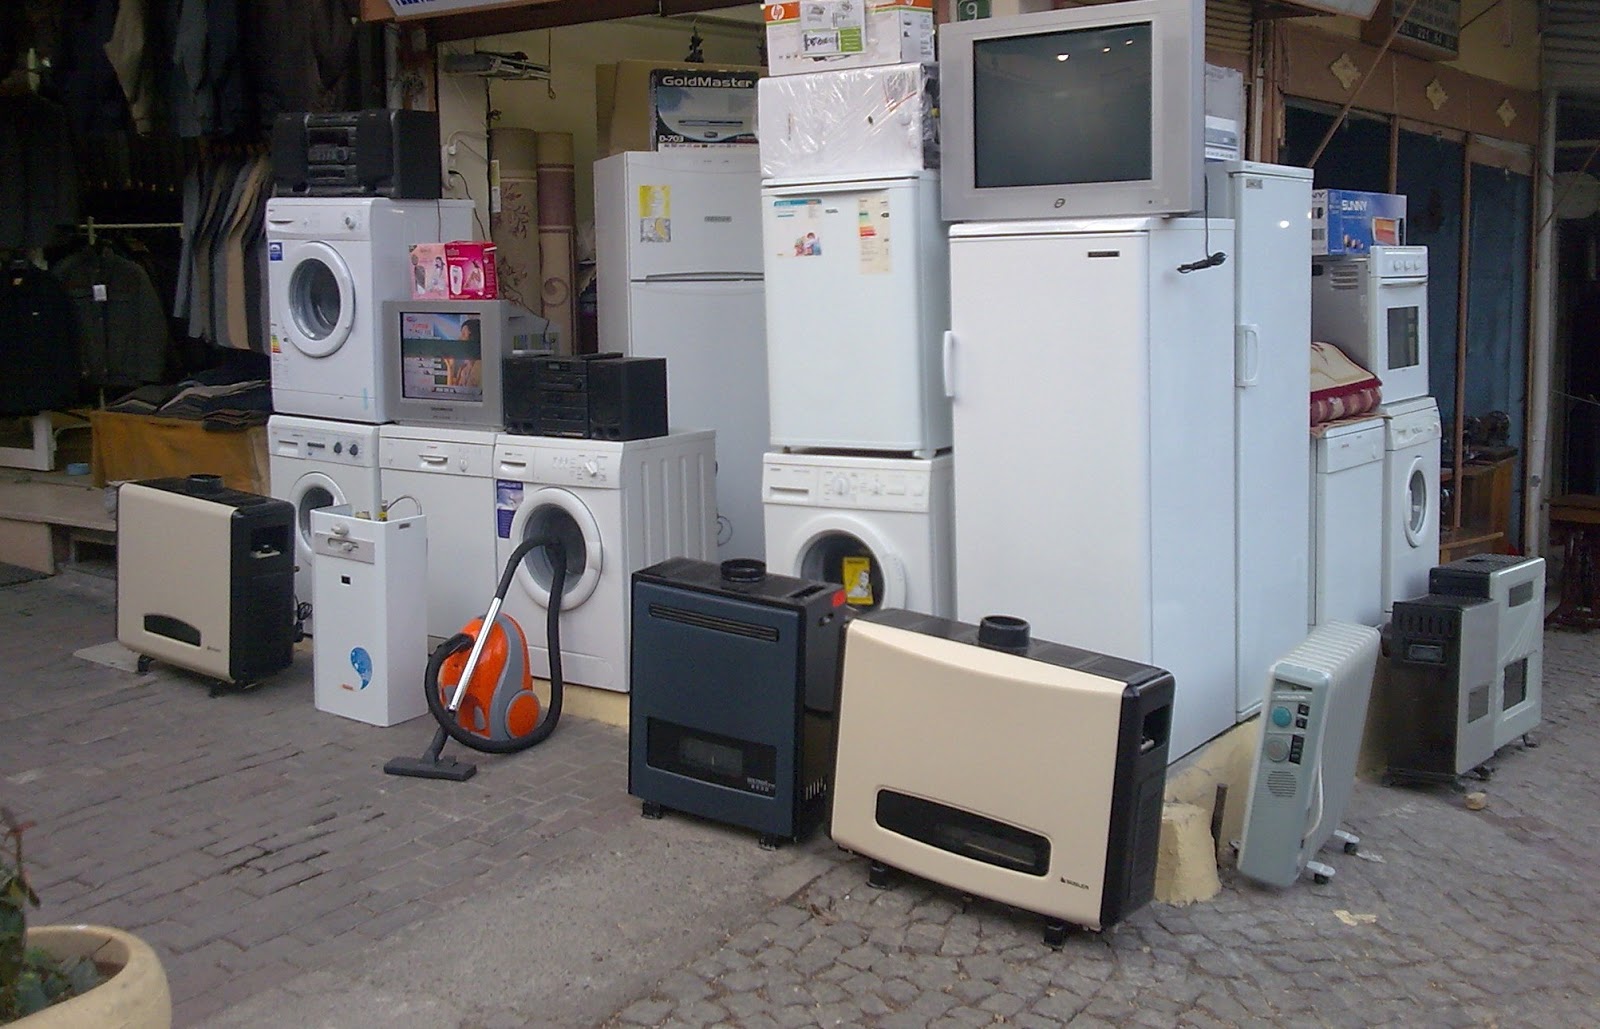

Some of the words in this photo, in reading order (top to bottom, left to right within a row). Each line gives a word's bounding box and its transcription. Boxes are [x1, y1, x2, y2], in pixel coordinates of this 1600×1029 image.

[966, 2, 978, 20] 9
[662, 75, 753, 88] GoldMaster
[1341, 199, 1368, 212] SUNNY
